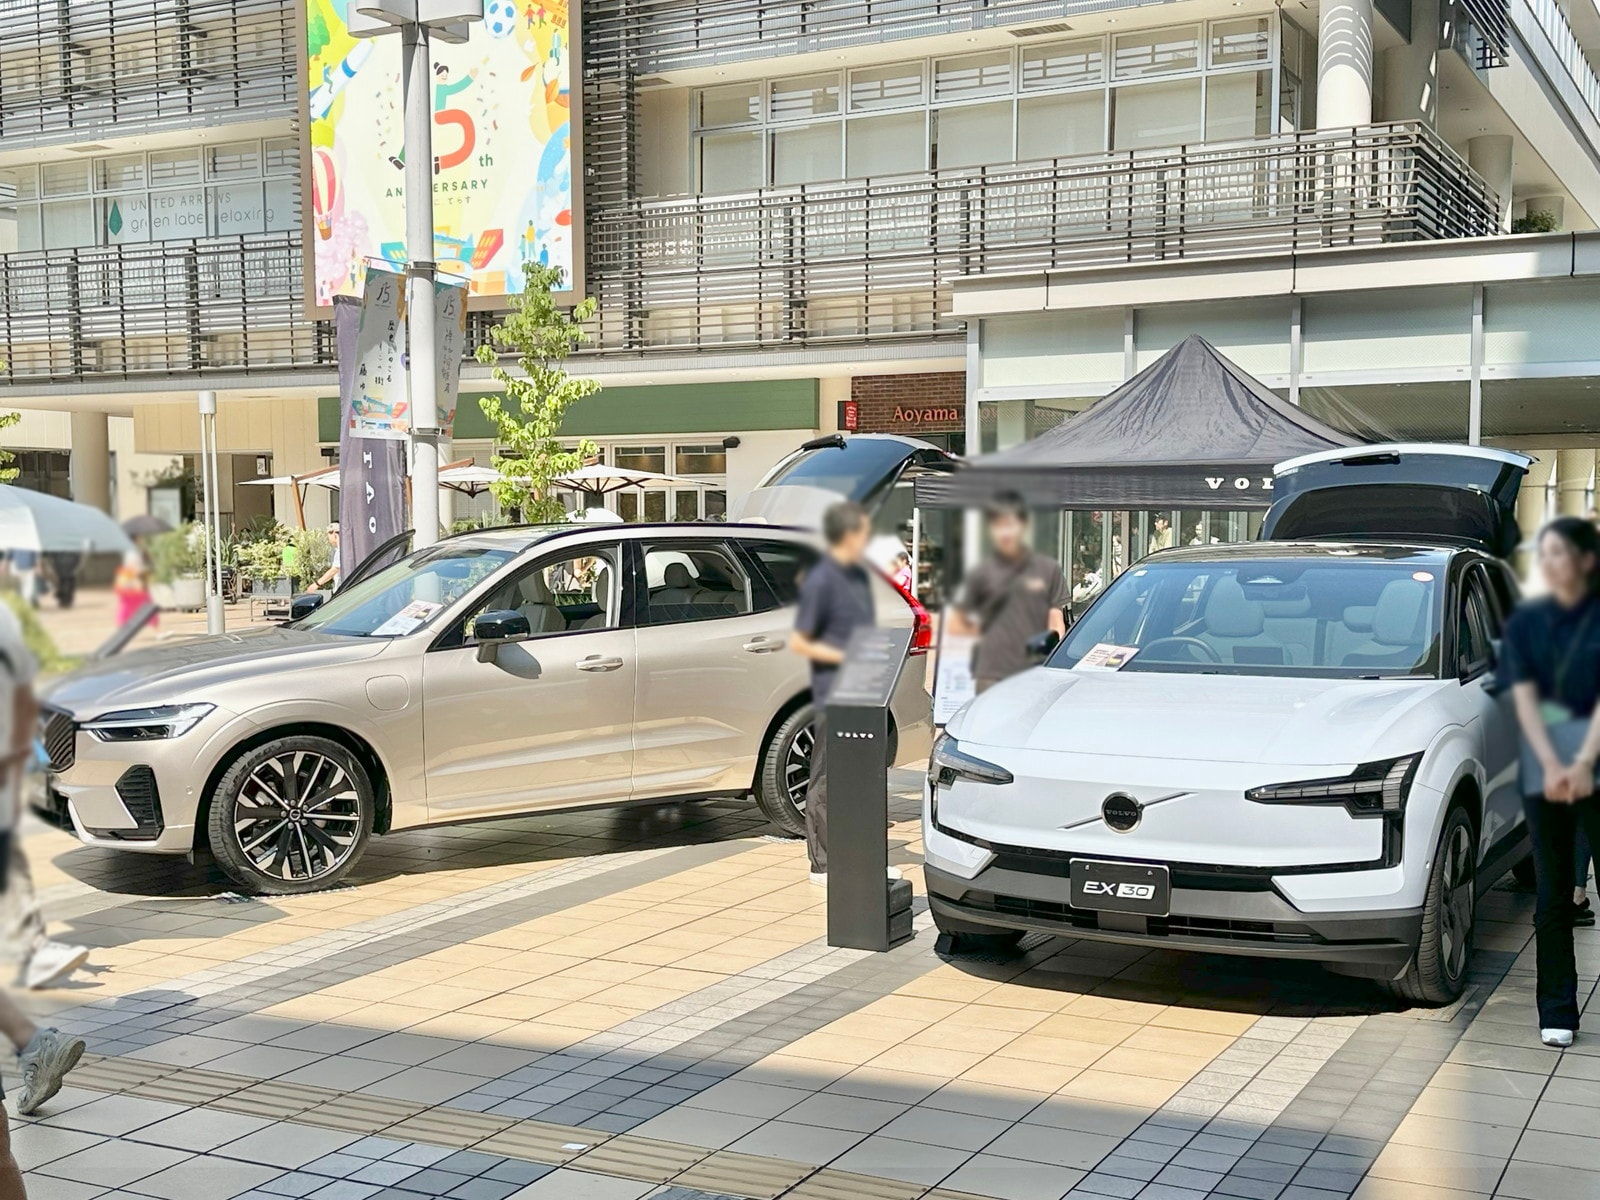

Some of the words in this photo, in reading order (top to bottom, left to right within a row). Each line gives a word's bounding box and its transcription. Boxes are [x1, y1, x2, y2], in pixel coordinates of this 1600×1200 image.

[386, 179, 488, 198] ANERSARY
[130, 196, 175, 211] UNTED
[131, 216, 170, 233] gren
[175, 211, 205, 227] labe
[220, 207, 275, 224] elaxing
[892, 405, 958, 425] Aoyama
[836, 731, 874, 739] VOLVO
[1106, 809, 1137, 817] VOLVO
